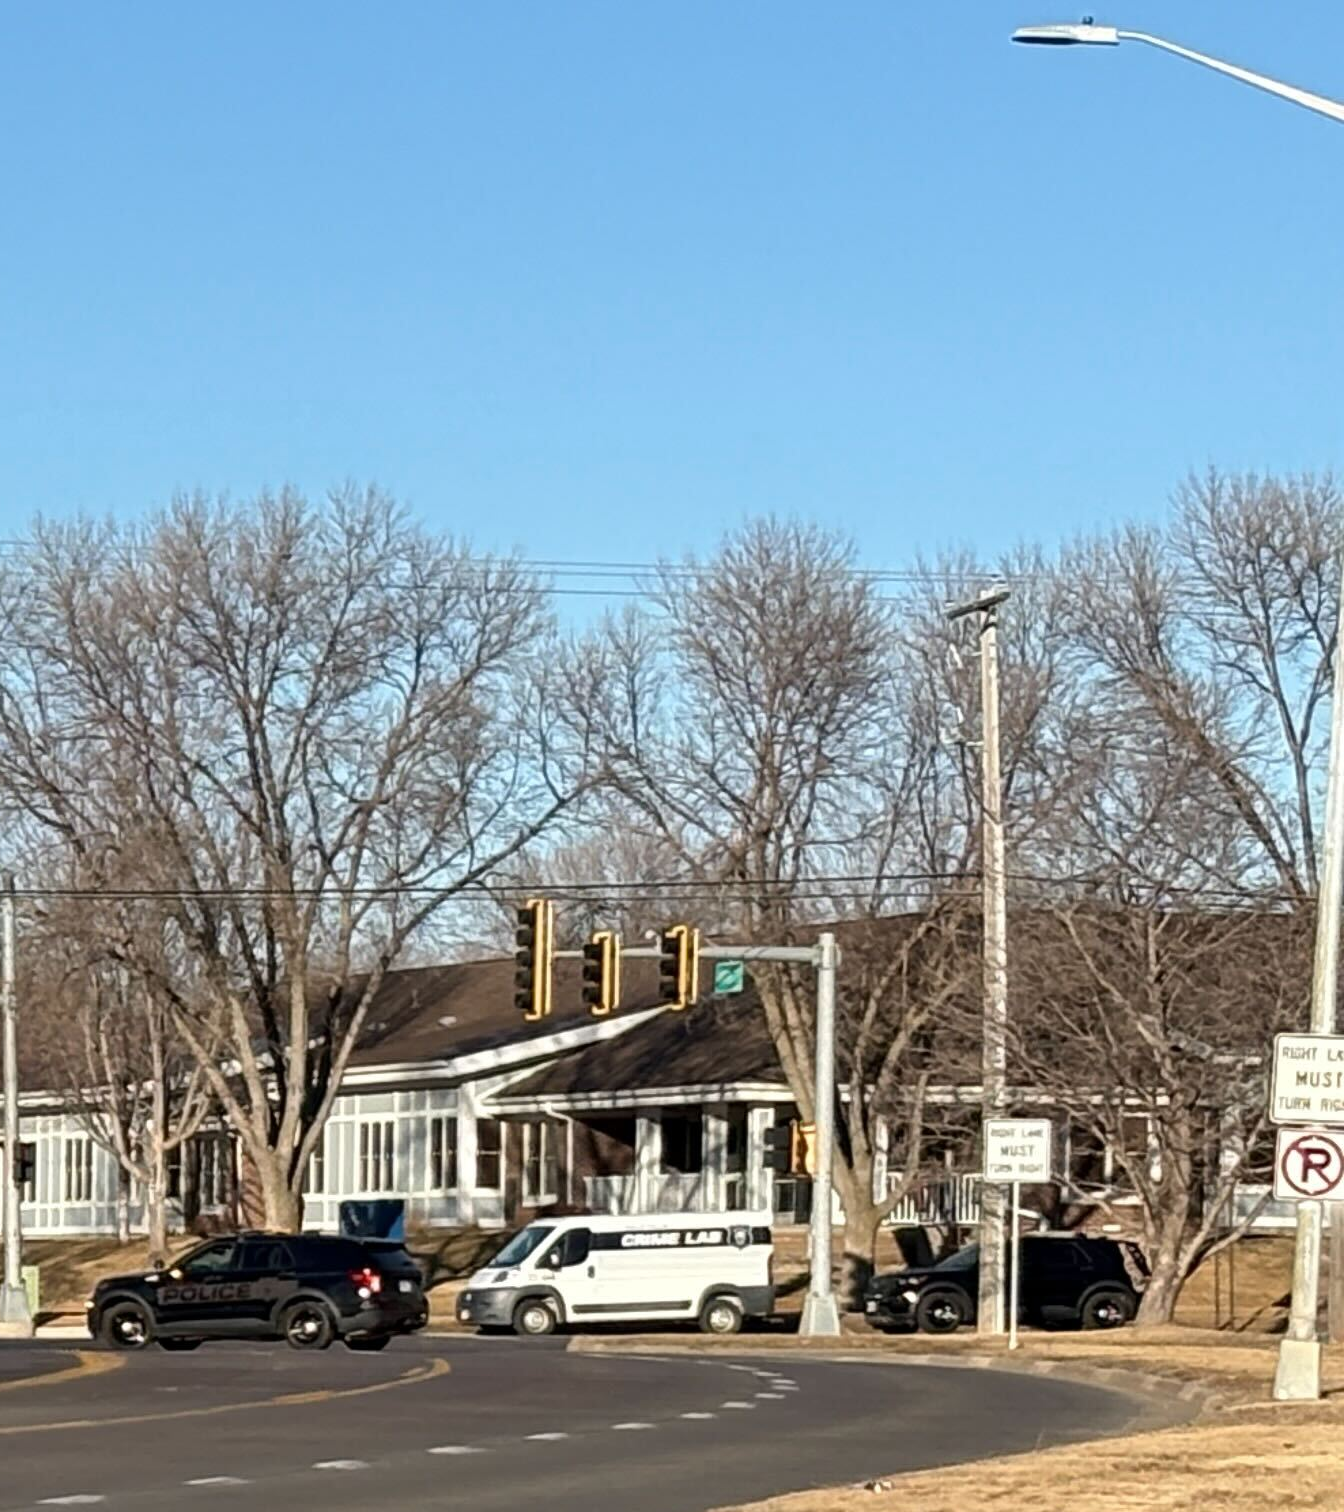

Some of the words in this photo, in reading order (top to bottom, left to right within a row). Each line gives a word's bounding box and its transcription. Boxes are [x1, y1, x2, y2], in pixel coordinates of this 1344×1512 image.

[1282, 1046, 1318, 1060] RIGHT
[1279, 1096, 1312, 1111] TURN
[1000, 1144, 1034, 1156] MUST
[621, 1231, 680, 1248] CRIME
[685, 1230, 722, 1245] LAB
[163, 1282, 251, 1301] POLICE
